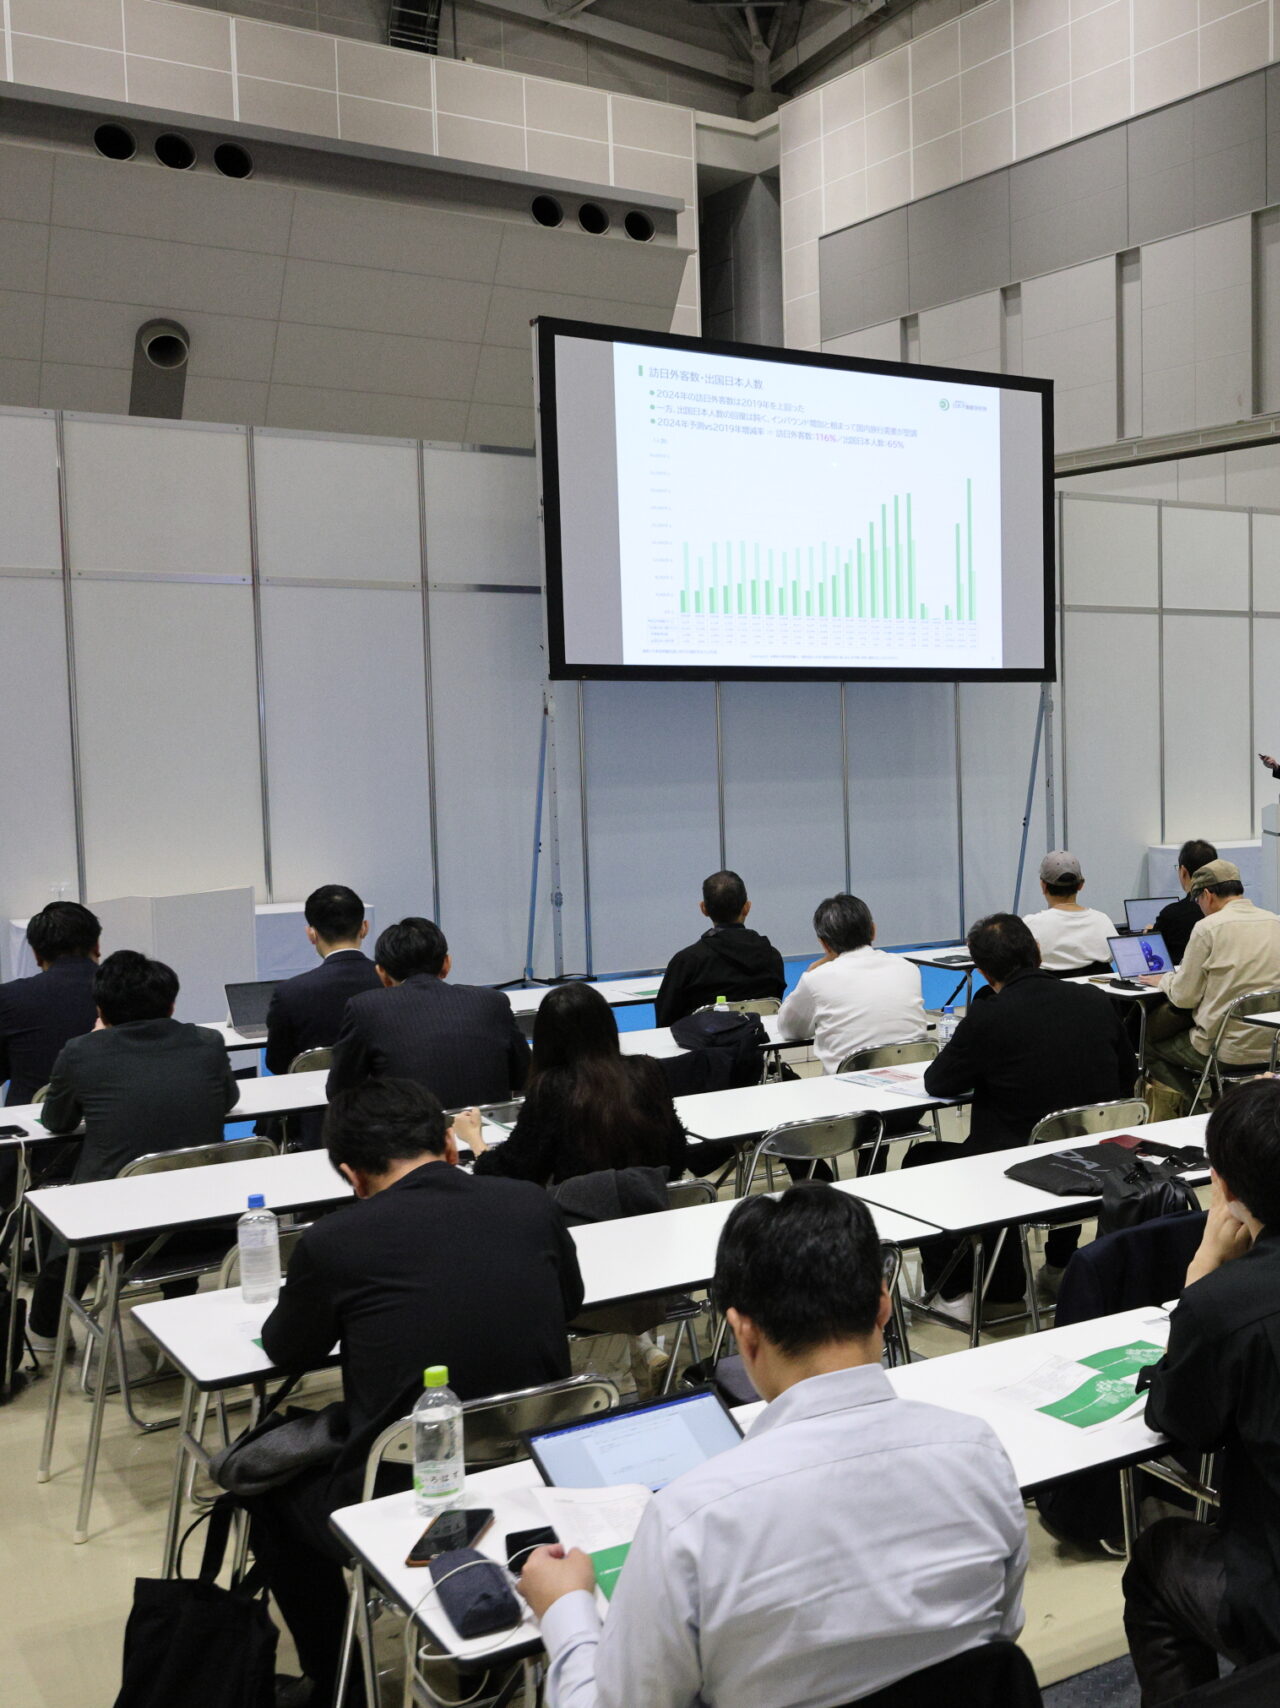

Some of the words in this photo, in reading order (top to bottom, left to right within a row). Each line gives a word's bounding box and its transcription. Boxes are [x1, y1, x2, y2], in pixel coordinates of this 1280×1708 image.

[648, 366, 763, 390] 訪日外客数・出国日本人数
